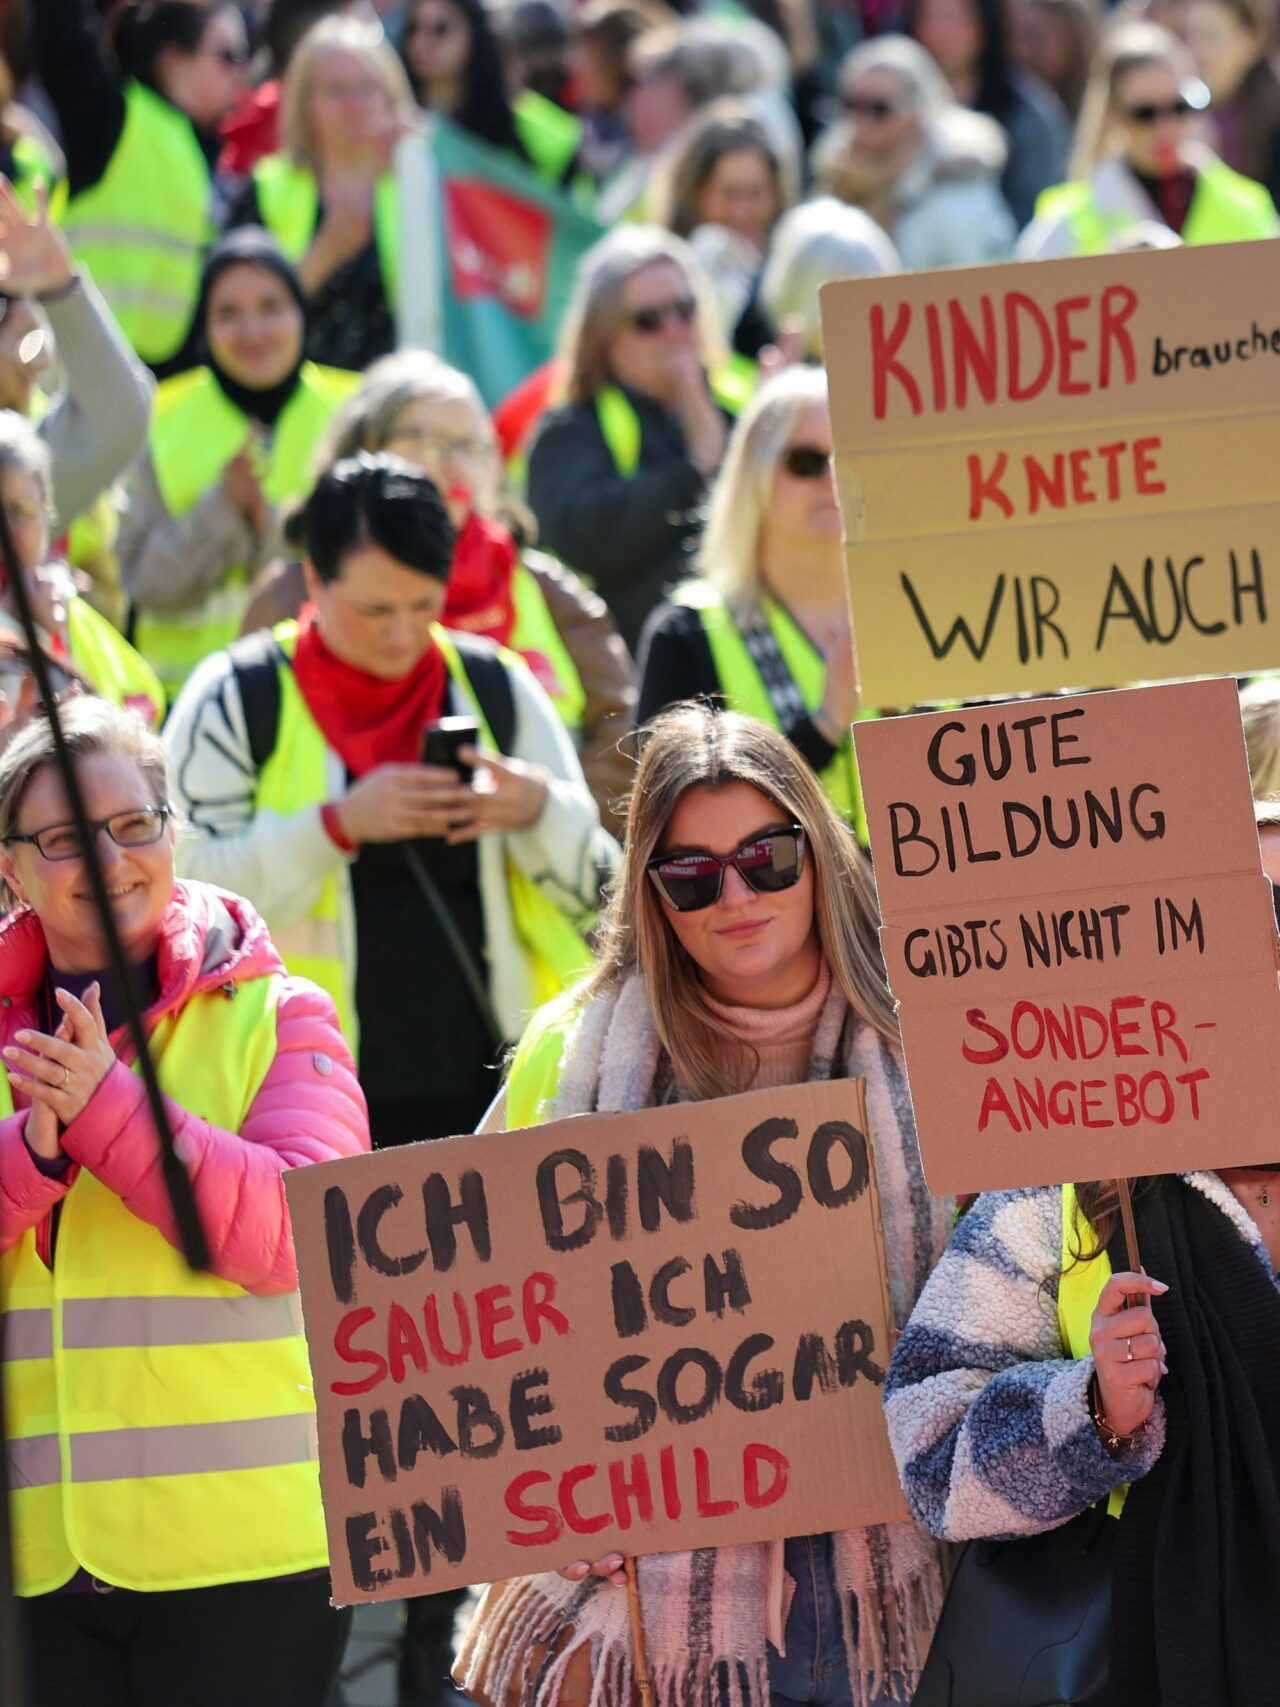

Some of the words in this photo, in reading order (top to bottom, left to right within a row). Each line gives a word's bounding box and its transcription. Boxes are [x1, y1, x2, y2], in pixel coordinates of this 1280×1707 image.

[869, 284, 1139, 420] KINDER
[968, 436, 1167, 522] KNETE
[900, 571, 1070, 665] WIR
[1095, 548, 1269, 652] AUCH
[927, 708, 1092, 787] GUTE
[887, 782, 1166, 877] BILDUNG
[904, 918, 1008, 979] GIBTS
[1019, 904, 1131, 969] NICHT
[1154, 897, 1206, 955] IM
[961, 995, 1218, 1065] SONDER-
[977, 1069, 1212, 1133] ANGEBOT
[323, 1168, 492, 1304] ICH
[536, 1135, 696, 1253] BIN
[730, 1117, 872, 1230] SO
[330, 1271, 572, 1396] SAUER
[610, 1247, 753, 1339] ICH
[341, 1367, 564, 1489] HABE
[603, 1318, 887, 1443] SOGAR
[345, 1484, 468, 1592] EIN
[504, 1442, 790, 1547] SCHILD
